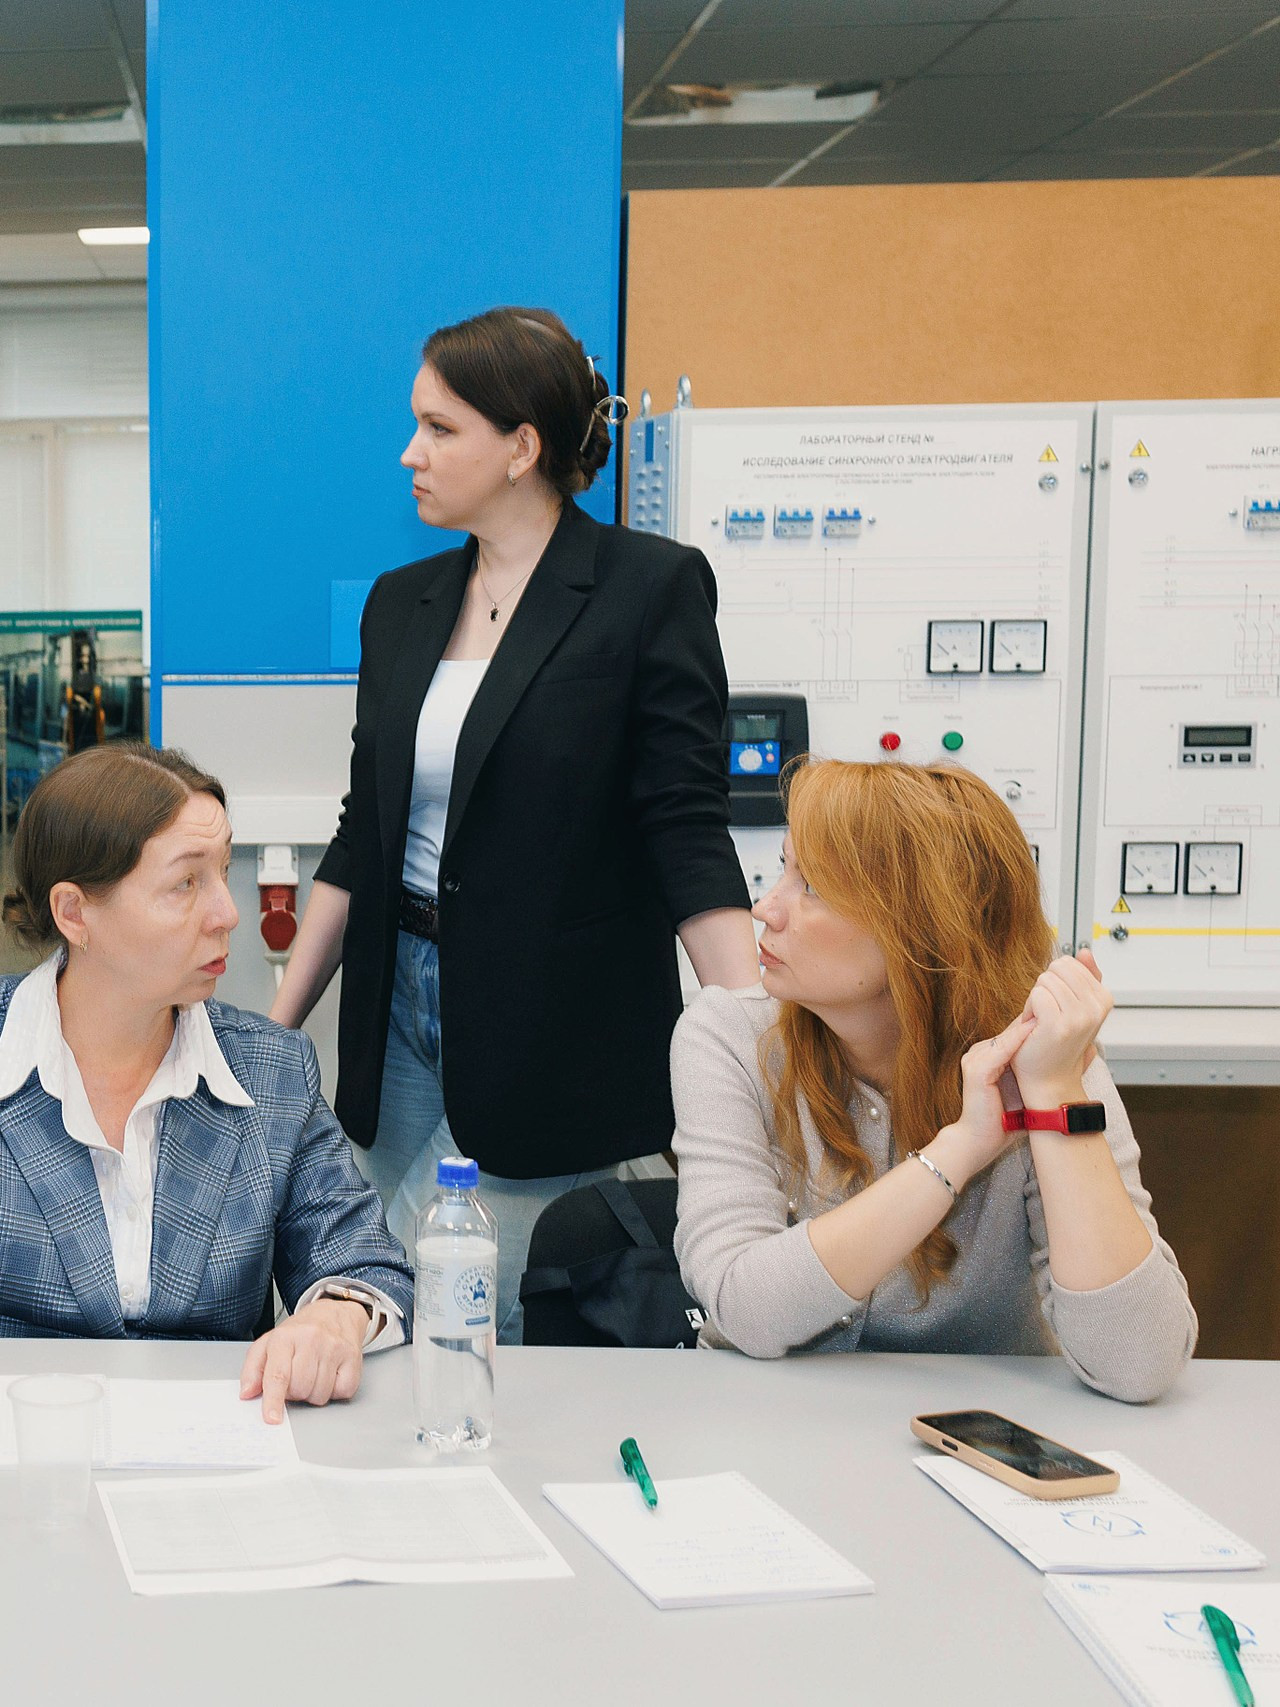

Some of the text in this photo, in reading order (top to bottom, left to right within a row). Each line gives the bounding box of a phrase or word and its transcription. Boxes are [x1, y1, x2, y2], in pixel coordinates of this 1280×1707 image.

[800, 434, 885, 445] ЛАБОРАТОРНЫЙ
[888, 434, 921, 446] СТЕНД
[743, 453, 1014, 468] ИССЛЕДОВАНИЕ СИНХРОННОГО ЭЛЕКТРОДВИГАТЕЛЯ
